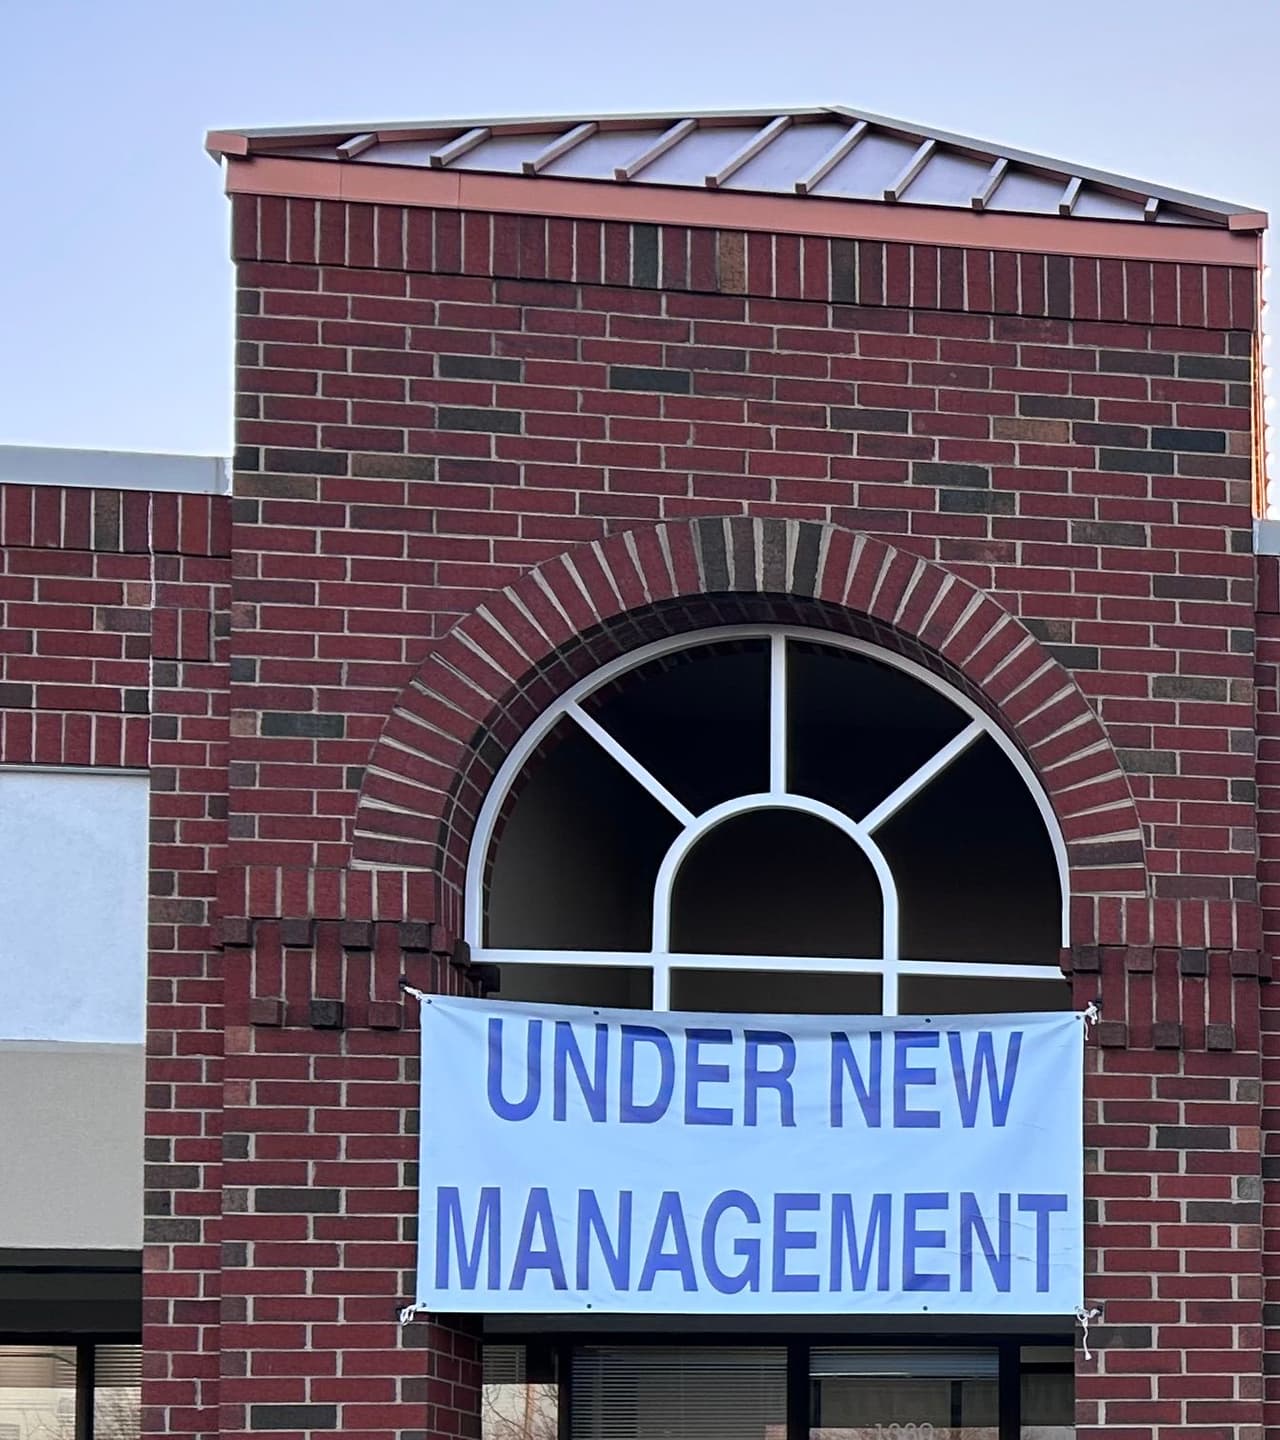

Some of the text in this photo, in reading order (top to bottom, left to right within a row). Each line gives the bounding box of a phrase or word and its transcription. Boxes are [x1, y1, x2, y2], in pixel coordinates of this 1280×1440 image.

[485, 1018, 1023, 1129] UNDER NEW
[434, 1186, 1068, 1295] MANAGEMENT
